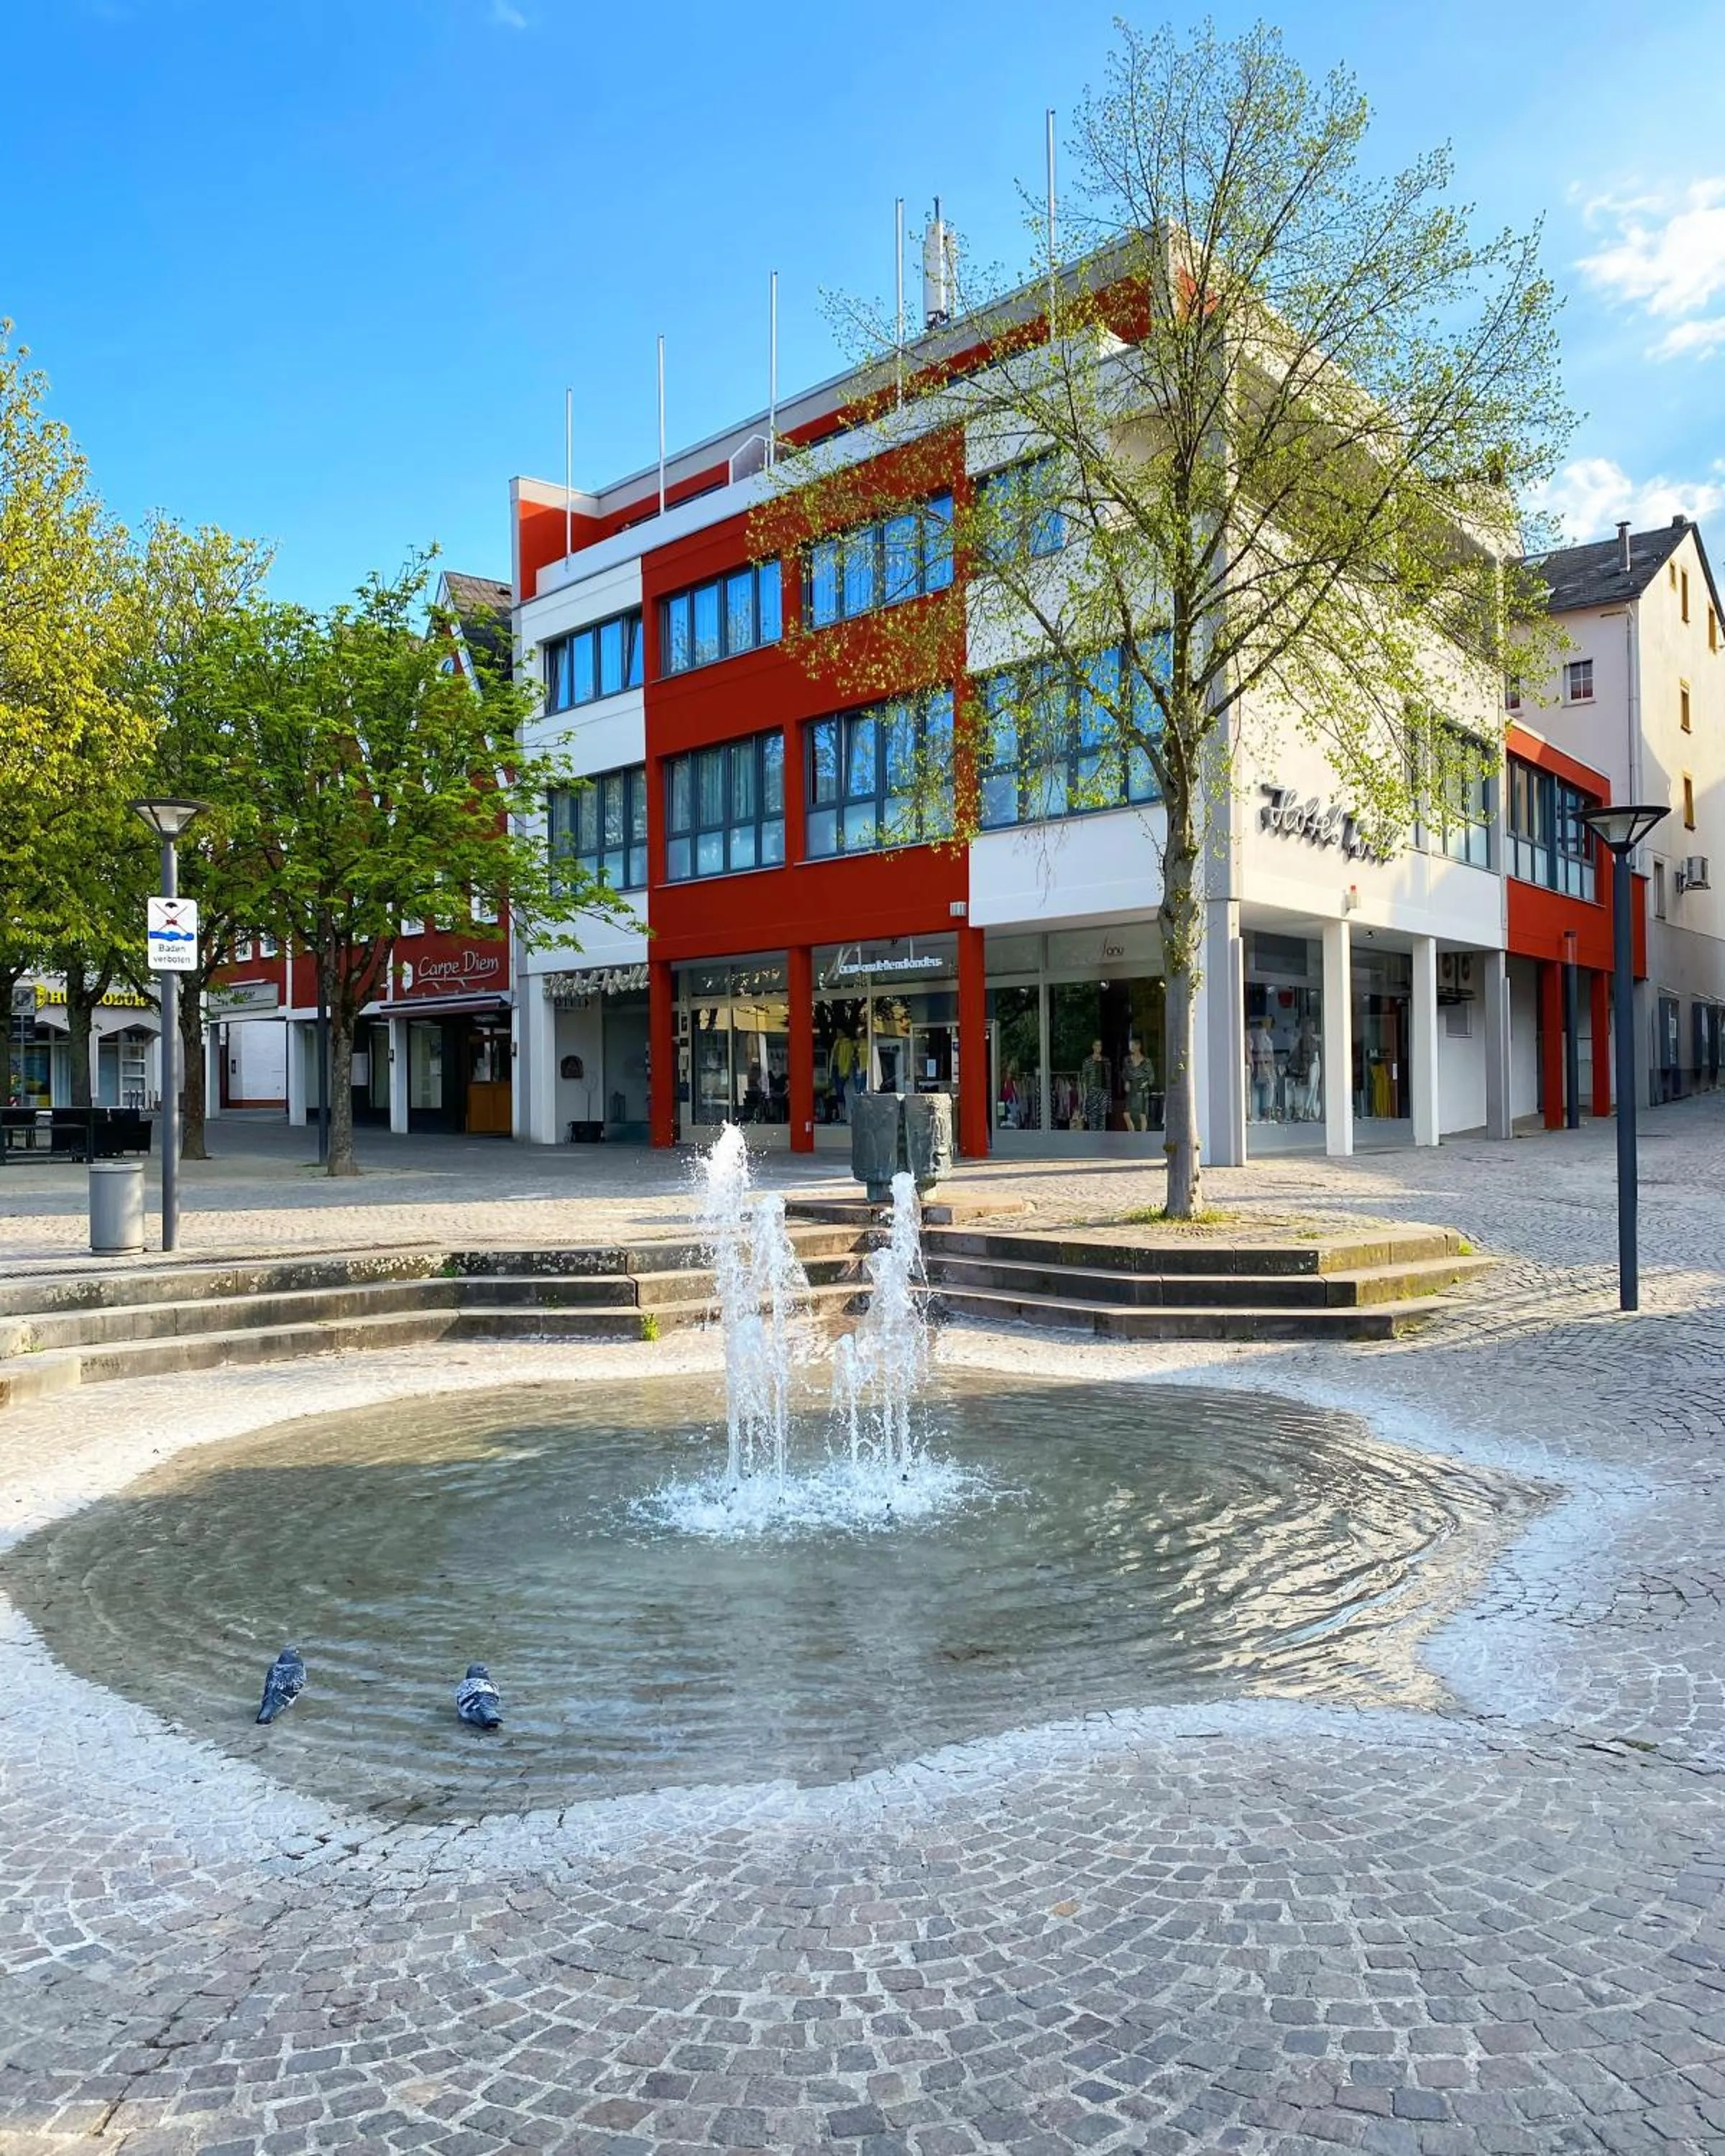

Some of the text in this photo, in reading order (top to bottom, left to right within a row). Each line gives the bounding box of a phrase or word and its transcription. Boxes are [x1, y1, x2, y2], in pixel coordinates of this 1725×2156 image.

[1257, 783, 1343, 847] Hotel
[159, 944, 186, 952] Baden
[418, 951, 499, 982] Carpe Diem
